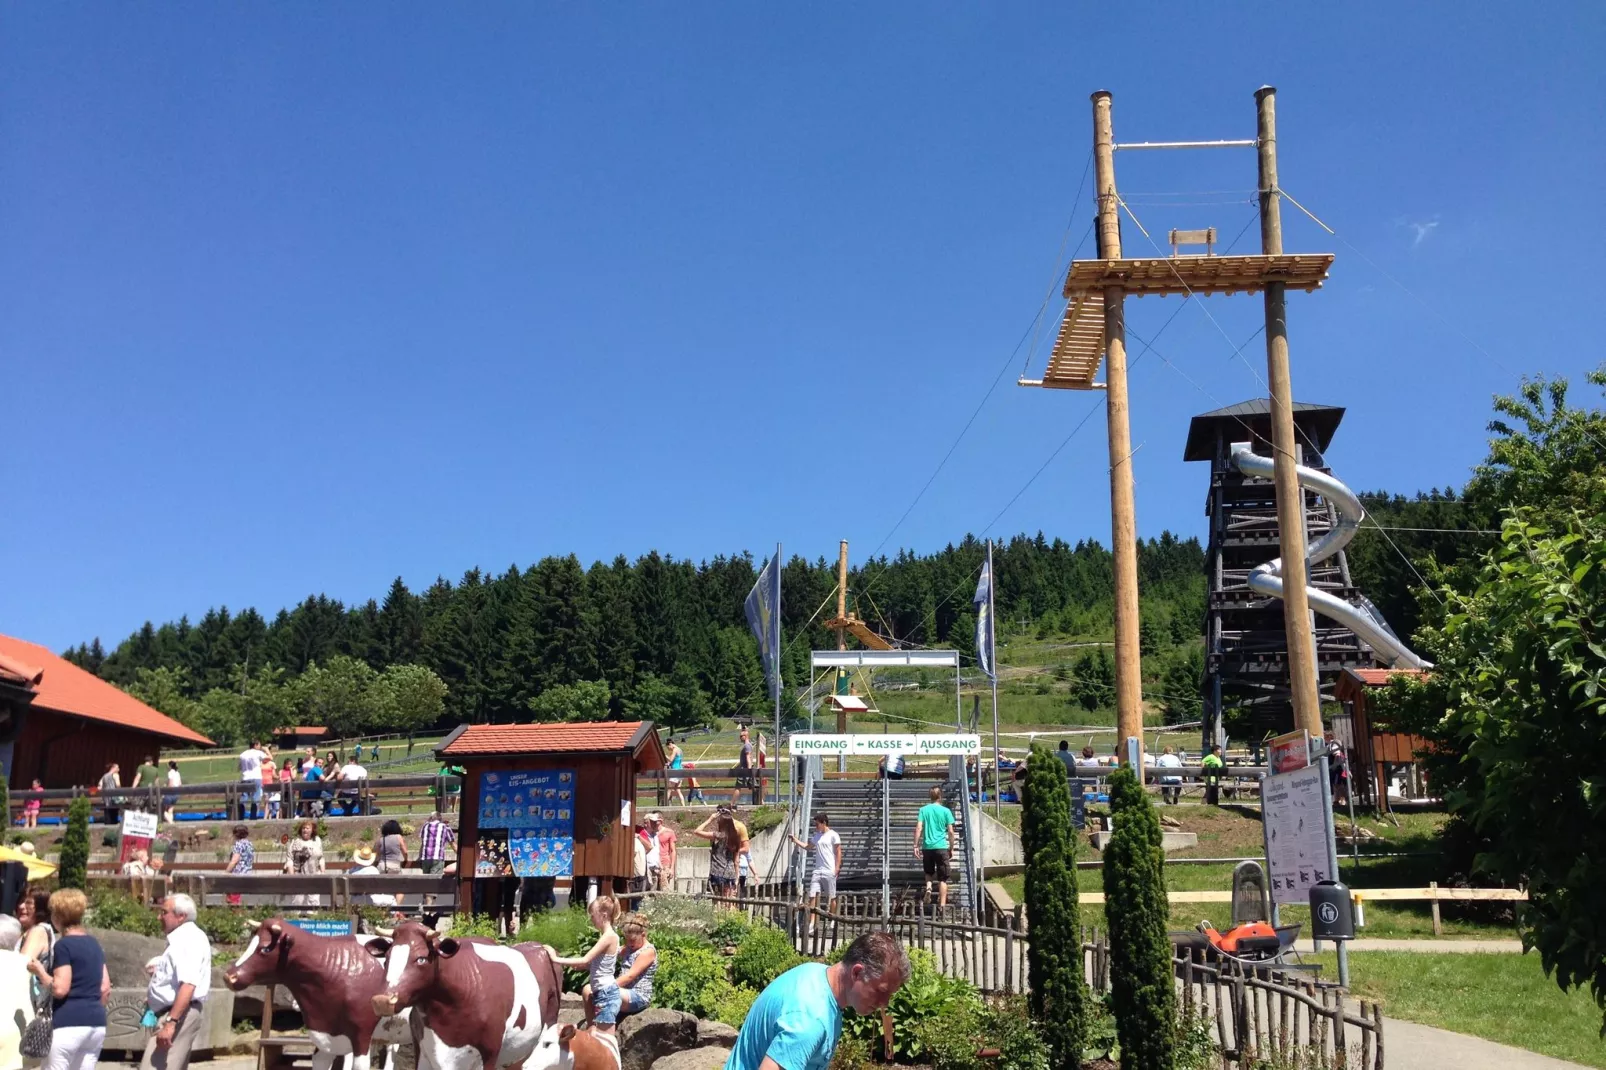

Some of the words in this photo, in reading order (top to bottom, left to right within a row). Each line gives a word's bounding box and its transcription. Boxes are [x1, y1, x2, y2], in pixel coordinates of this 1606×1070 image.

[794, 740, 848, 749] EINGANG
[868, 740, 902, 749] KASSE
[920, 740, 977, 749] AUSGANG
[509, 773, 528, 781] UNSER
[508, 777, 550, 787] EIS-ANGEBOT
